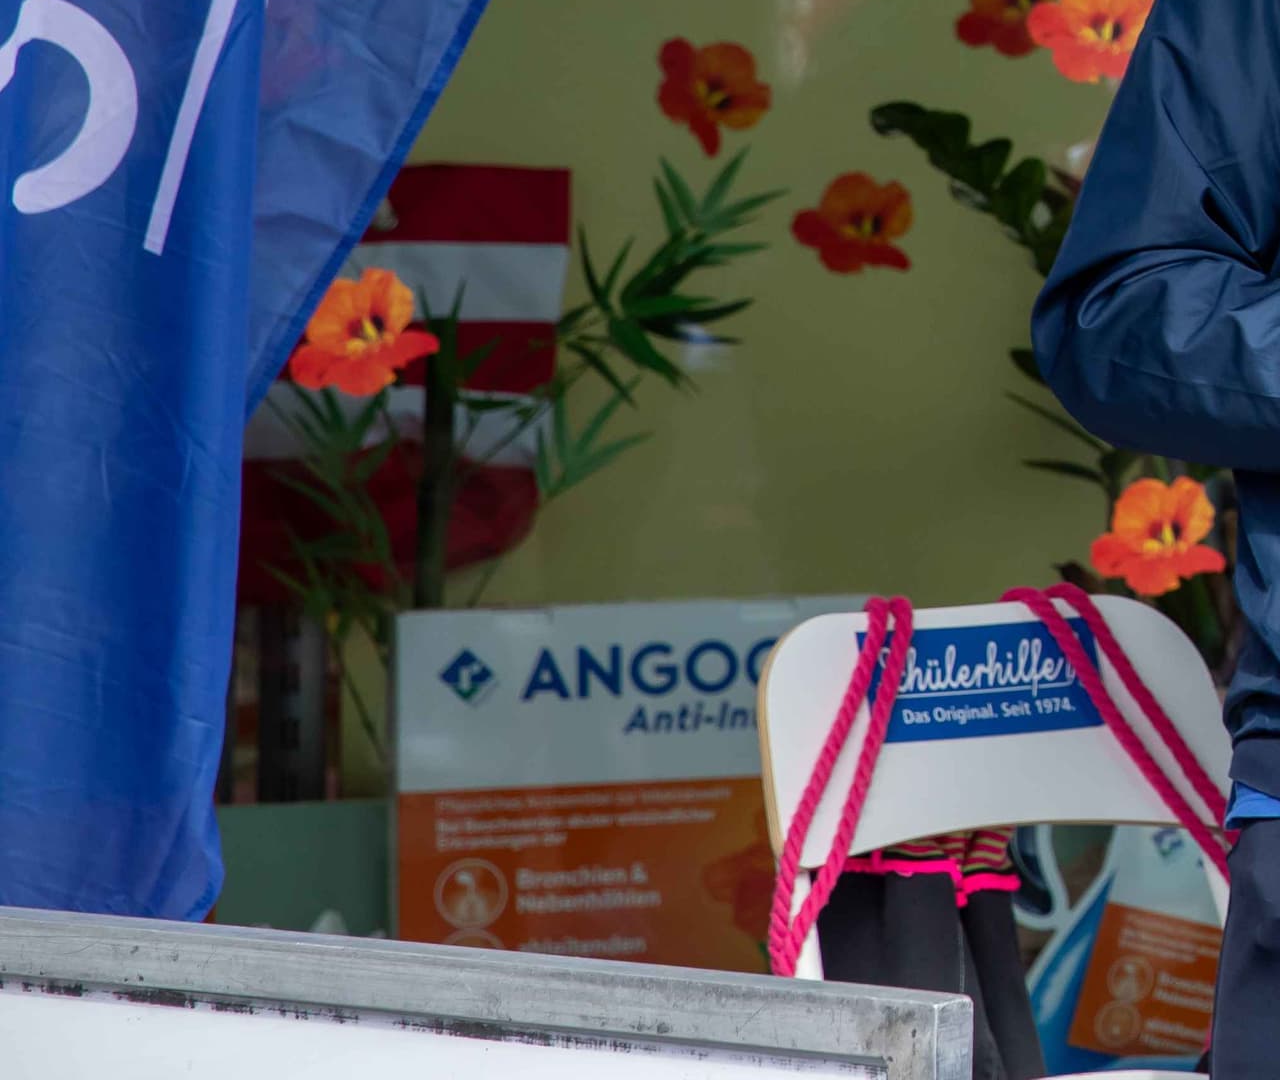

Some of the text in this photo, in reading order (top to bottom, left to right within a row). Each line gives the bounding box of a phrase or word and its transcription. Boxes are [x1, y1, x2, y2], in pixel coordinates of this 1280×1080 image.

[624, 700, 760, 736] Anti-In
[903, 696, 1076, 725] Das Original. Seit 1974.
